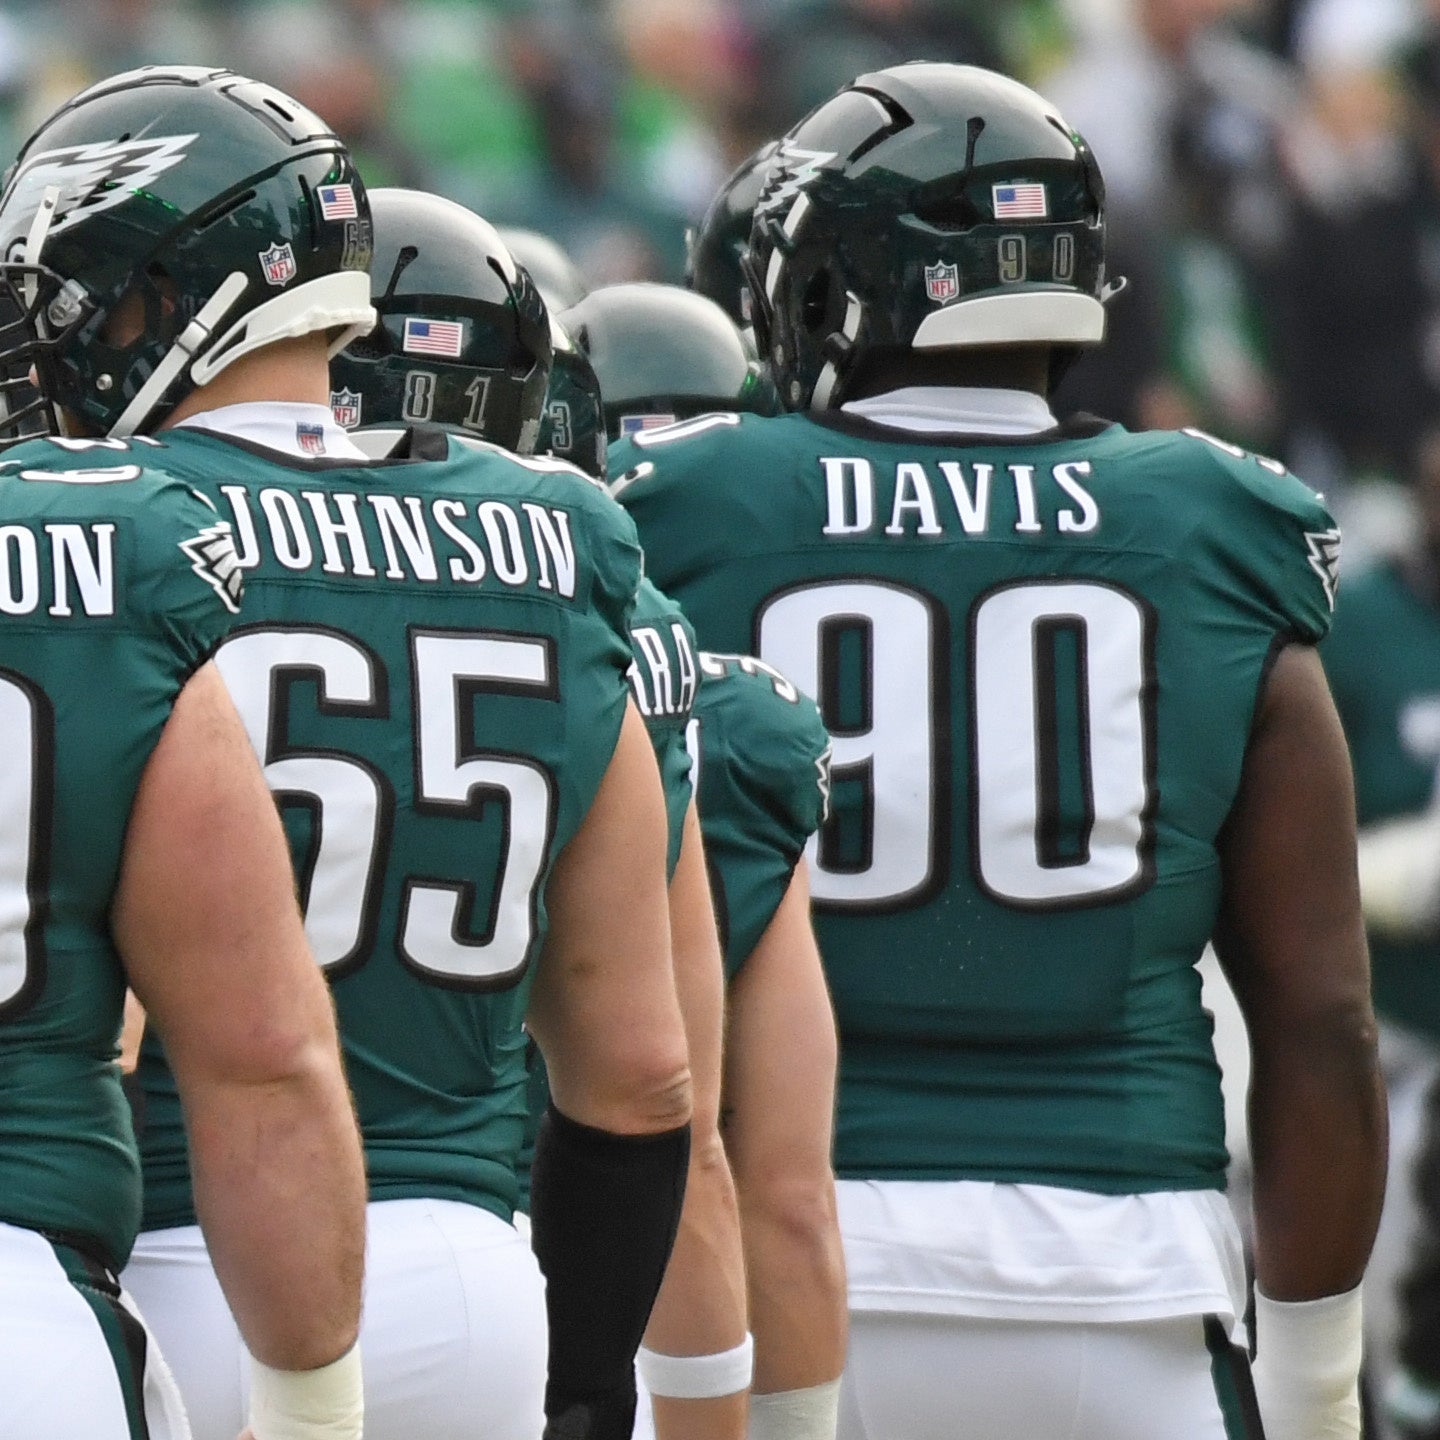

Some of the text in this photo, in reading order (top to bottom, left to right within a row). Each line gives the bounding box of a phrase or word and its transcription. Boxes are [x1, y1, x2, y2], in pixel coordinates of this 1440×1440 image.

[998, 233, 1075, 283] 90
[401, 369, 492, 431] 81
[219, 484, 578, 600] JOHNSON
[819, 456, 1101, 536] DAVIS
[760, 582, 1148, 902] 90
[212, 628, 552, 980] 65
